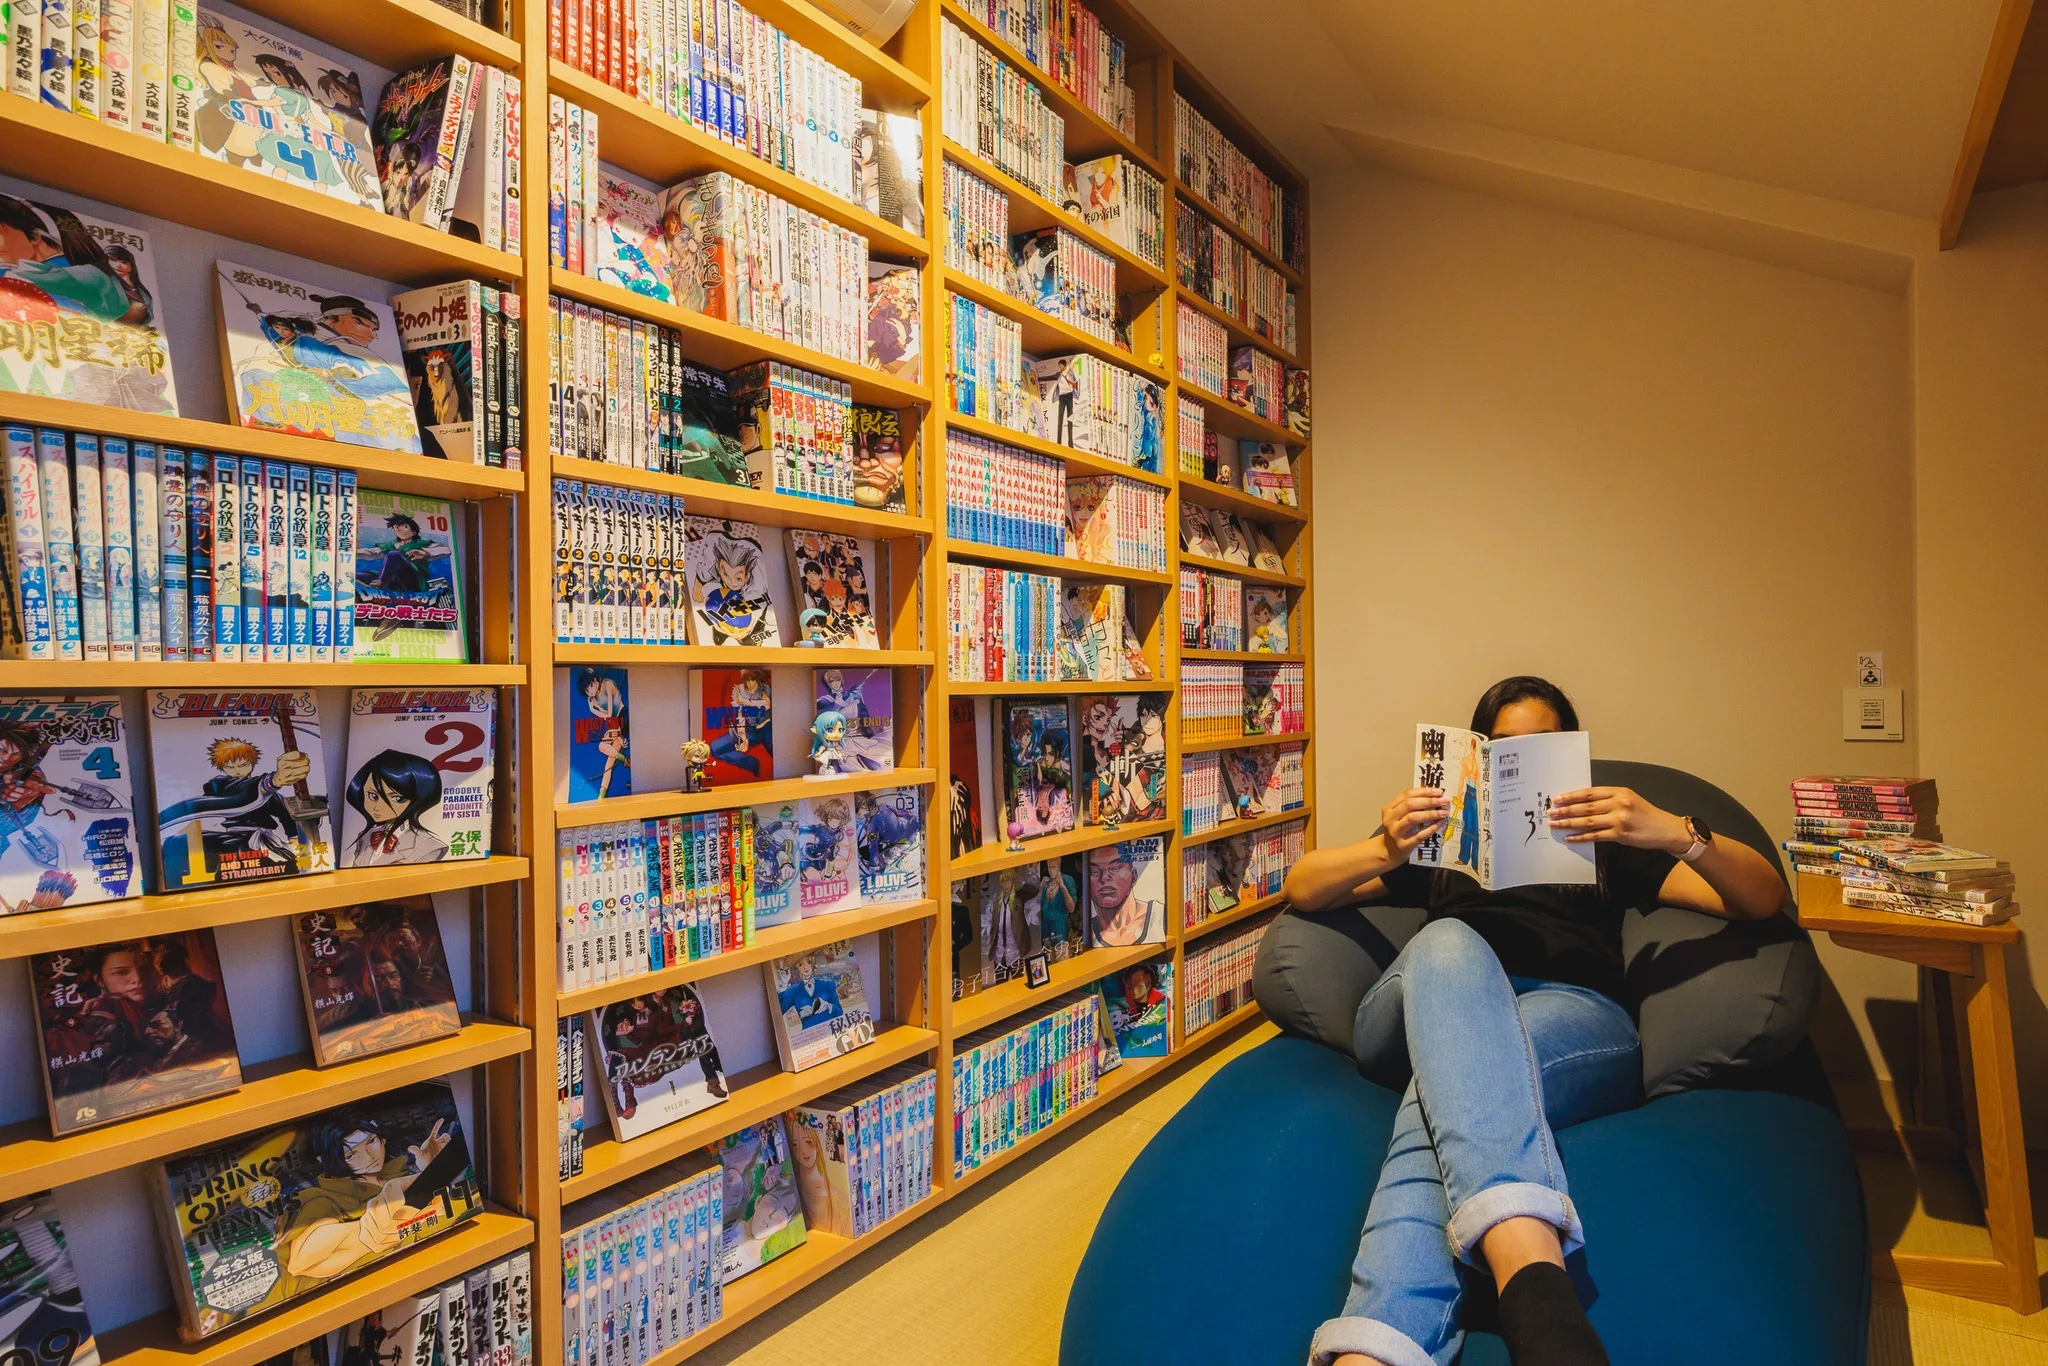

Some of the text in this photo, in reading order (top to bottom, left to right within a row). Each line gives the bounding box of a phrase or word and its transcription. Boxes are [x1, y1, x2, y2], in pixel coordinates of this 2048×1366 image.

[276, 141, 318, 181] 4
[454, 324, 460, 340] 3
[736, 470, 746, 484] 3
[427, 516, 448, 531] 10
[221, 545, 235, 555] 2
[246, 546, 260, 556] 5
[273, 548, 282, 558] 11
[294, 549, 307, 560] 12
[316, 552, 329, 563] 16
[340, 554, 351, 564] 17
[355, 603, 457, 622] デンの戦士たち
[372, 691, 469, 707] BLEACH
[425, 721, 485, 772] 2
[82, 747, 121, 779] 4
[444, 787, 481, 795] GOODBYE
[443, 802, 483, 811] GOODNITE
[896, 797, 914, 810] 03
[443, 810, 480, 819] MY SISTA
[1524, 810, 1536, 846] 3
[182, 819, 216, 885] 1
[576, 844, 588, 876] MIX
[603, 842, 615, 872] MIX
[617, 838, 629, 869] MIX
[630, 837, 643, 867] MIX
[221, 859, 260, 871] AND THE
[221, 865, 286, 880] STRAWBERRY
[309, 912, 337, 958] 史記
[50, 955, 84, 1007] 史記
[433, 1179, 475, 1219] 11
[213, 1251, 265, 1280] 完全版
[720, 1261, 743, 1278] 橋しん
[492, 1277, 510, 1346] バガボンド
